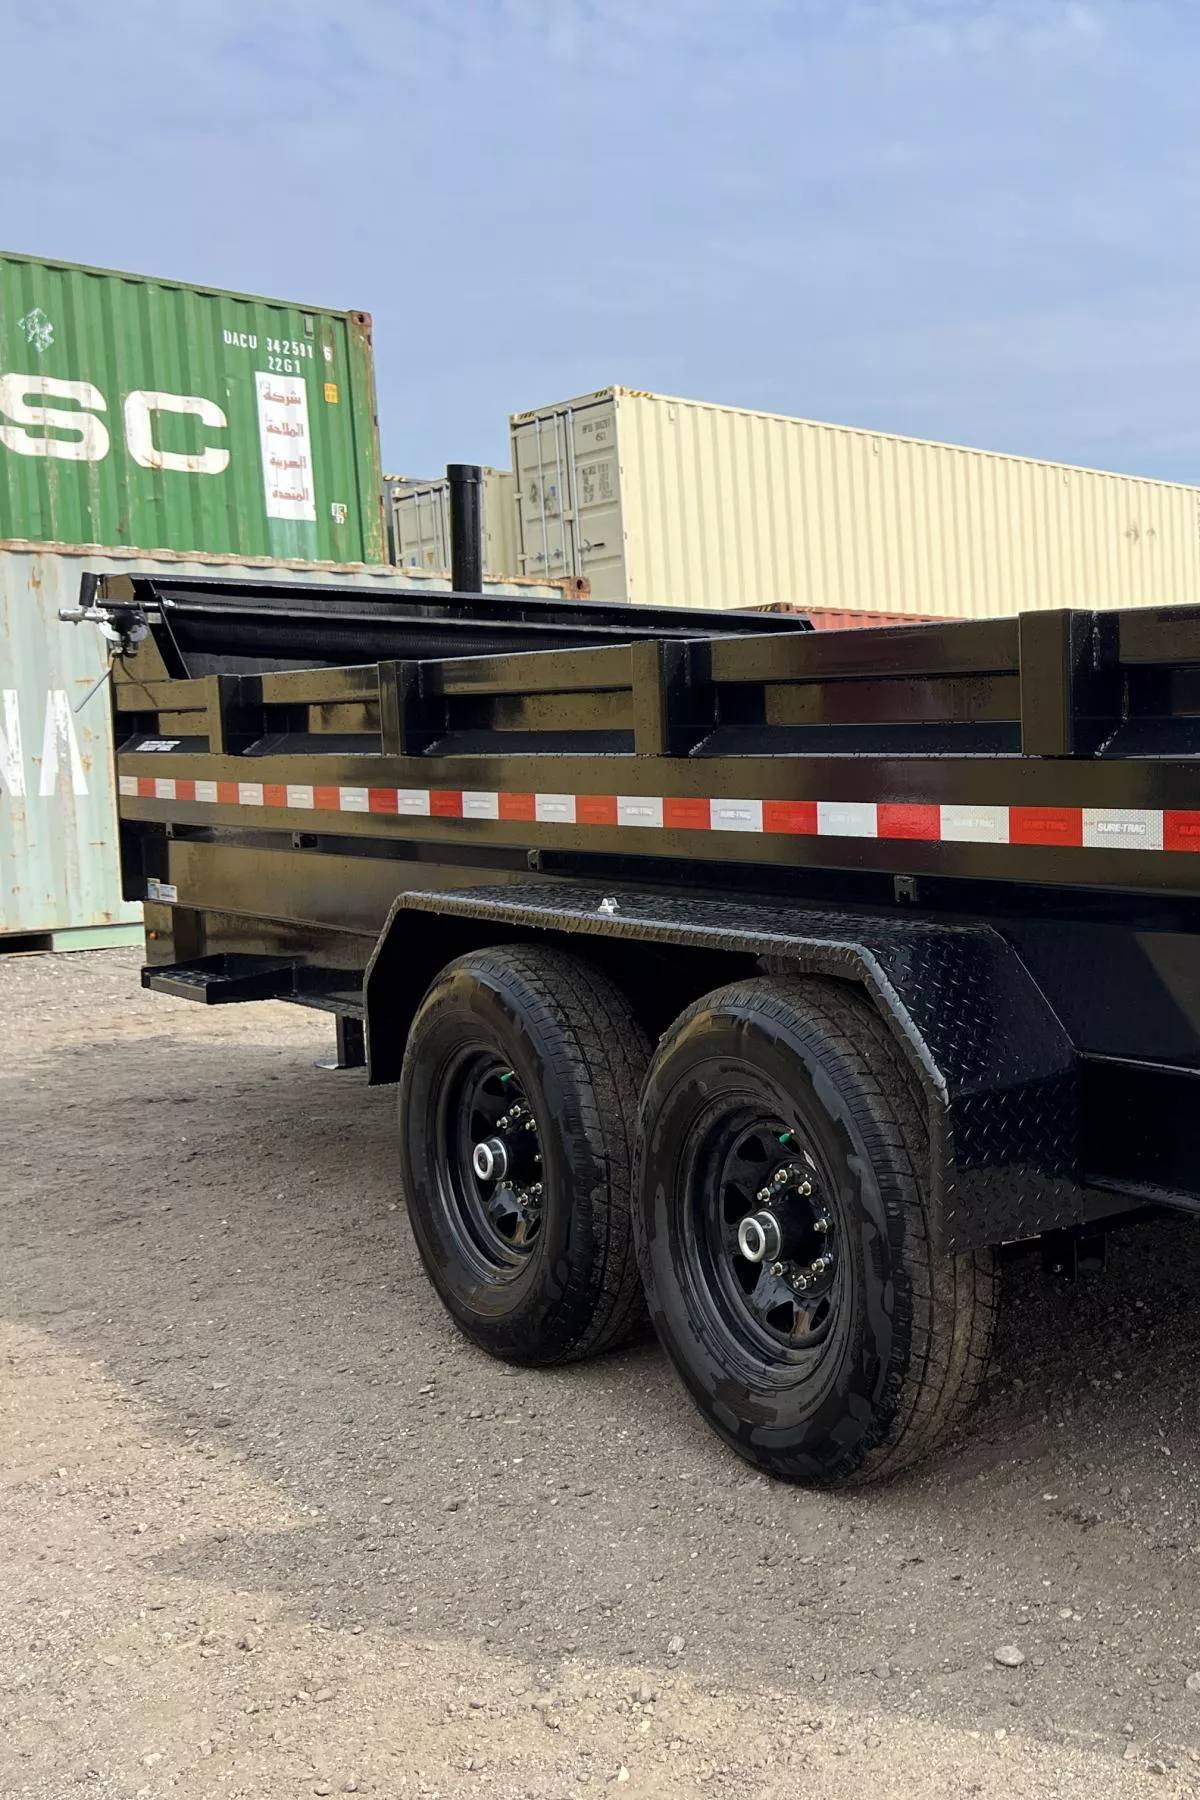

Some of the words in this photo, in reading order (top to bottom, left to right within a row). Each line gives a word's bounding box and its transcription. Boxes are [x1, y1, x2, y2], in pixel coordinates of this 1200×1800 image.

[223, 329, 258, 350] UACU
[266, 337, 313, 359] 342591
[323, 344, 333, 362] 6
[268, 356, 301, 374] 22G1
[1097, 822, 1146, 834] SURE-TRAC
